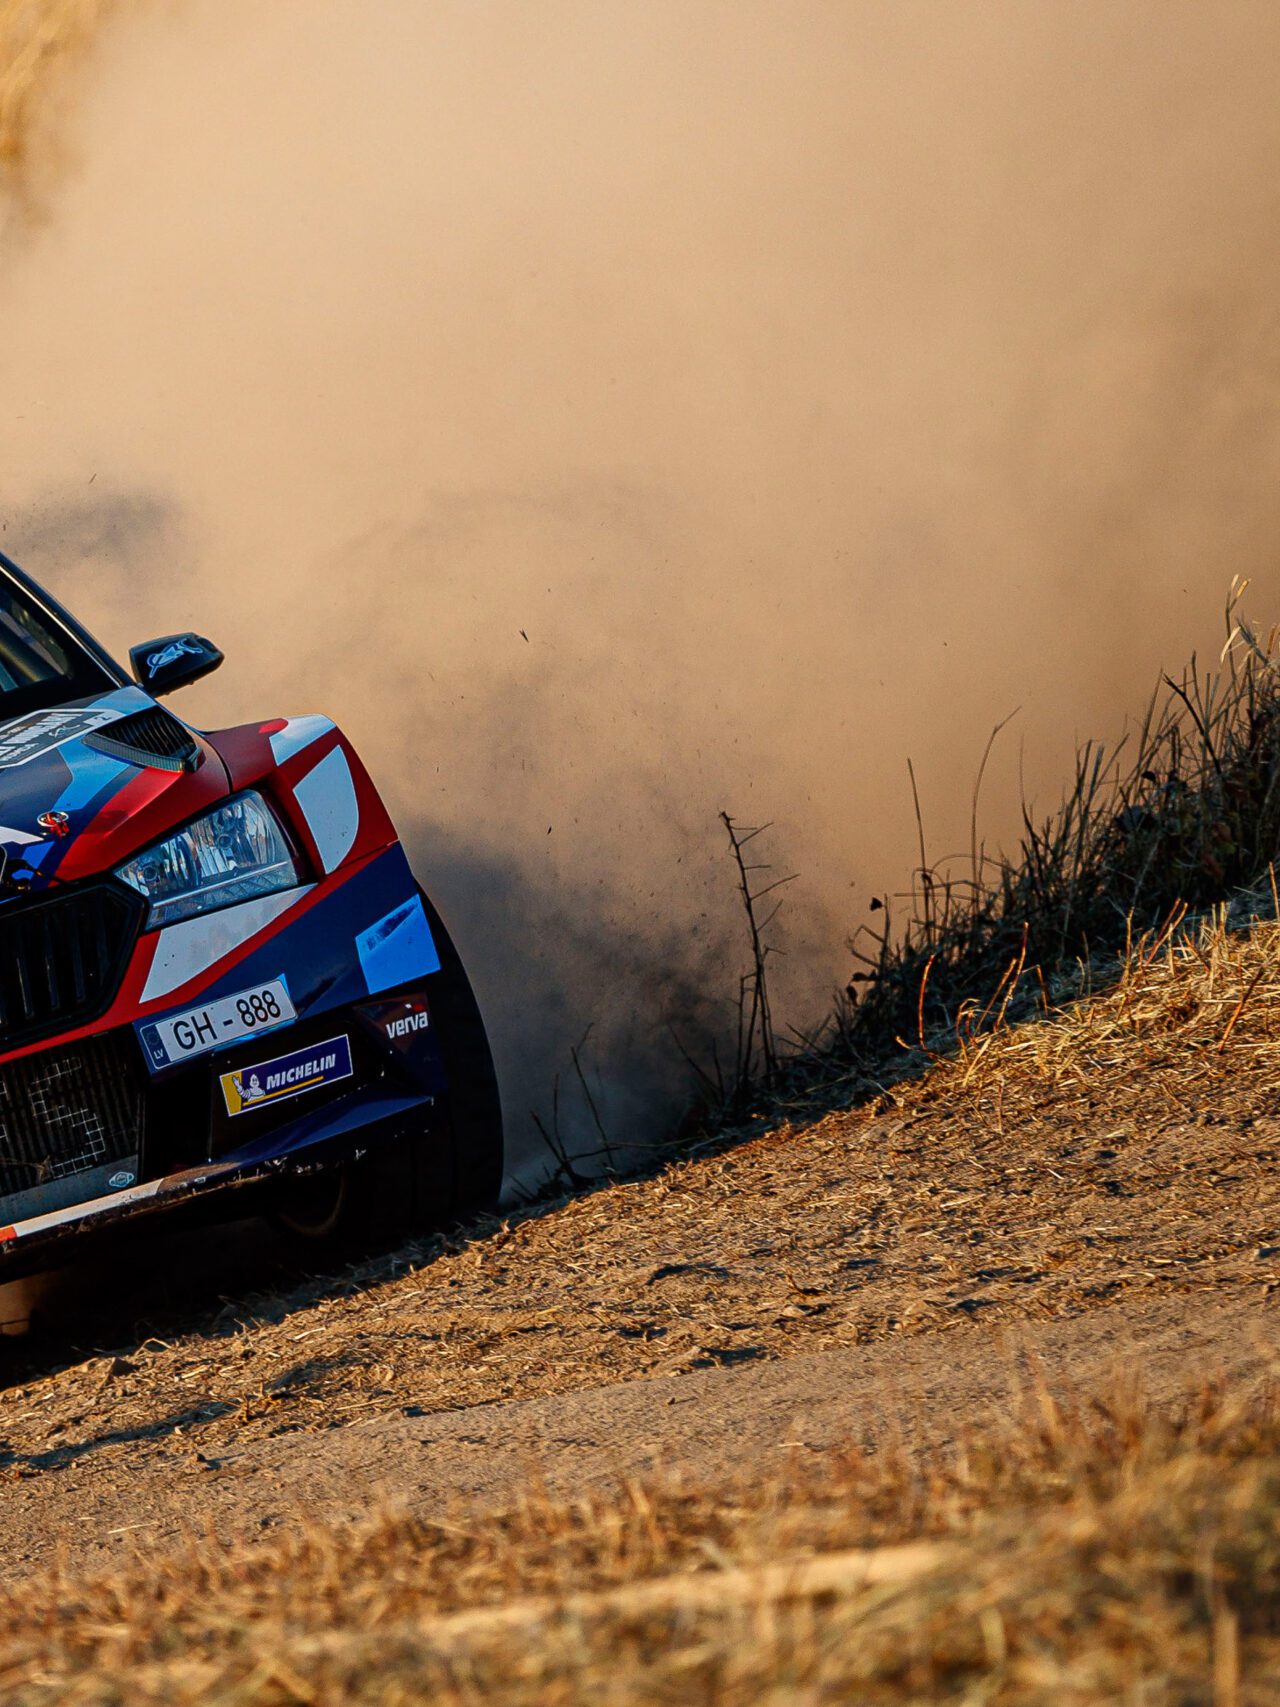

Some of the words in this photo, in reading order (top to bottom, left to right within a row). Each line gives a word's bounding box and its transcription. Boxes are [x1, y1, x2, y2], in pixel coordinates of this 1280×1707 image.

[385, 1011, 429, 1039] verva
[153, 1048, 164, 1060] LV
[266, 1053, 336, 1091] MICHELIN
